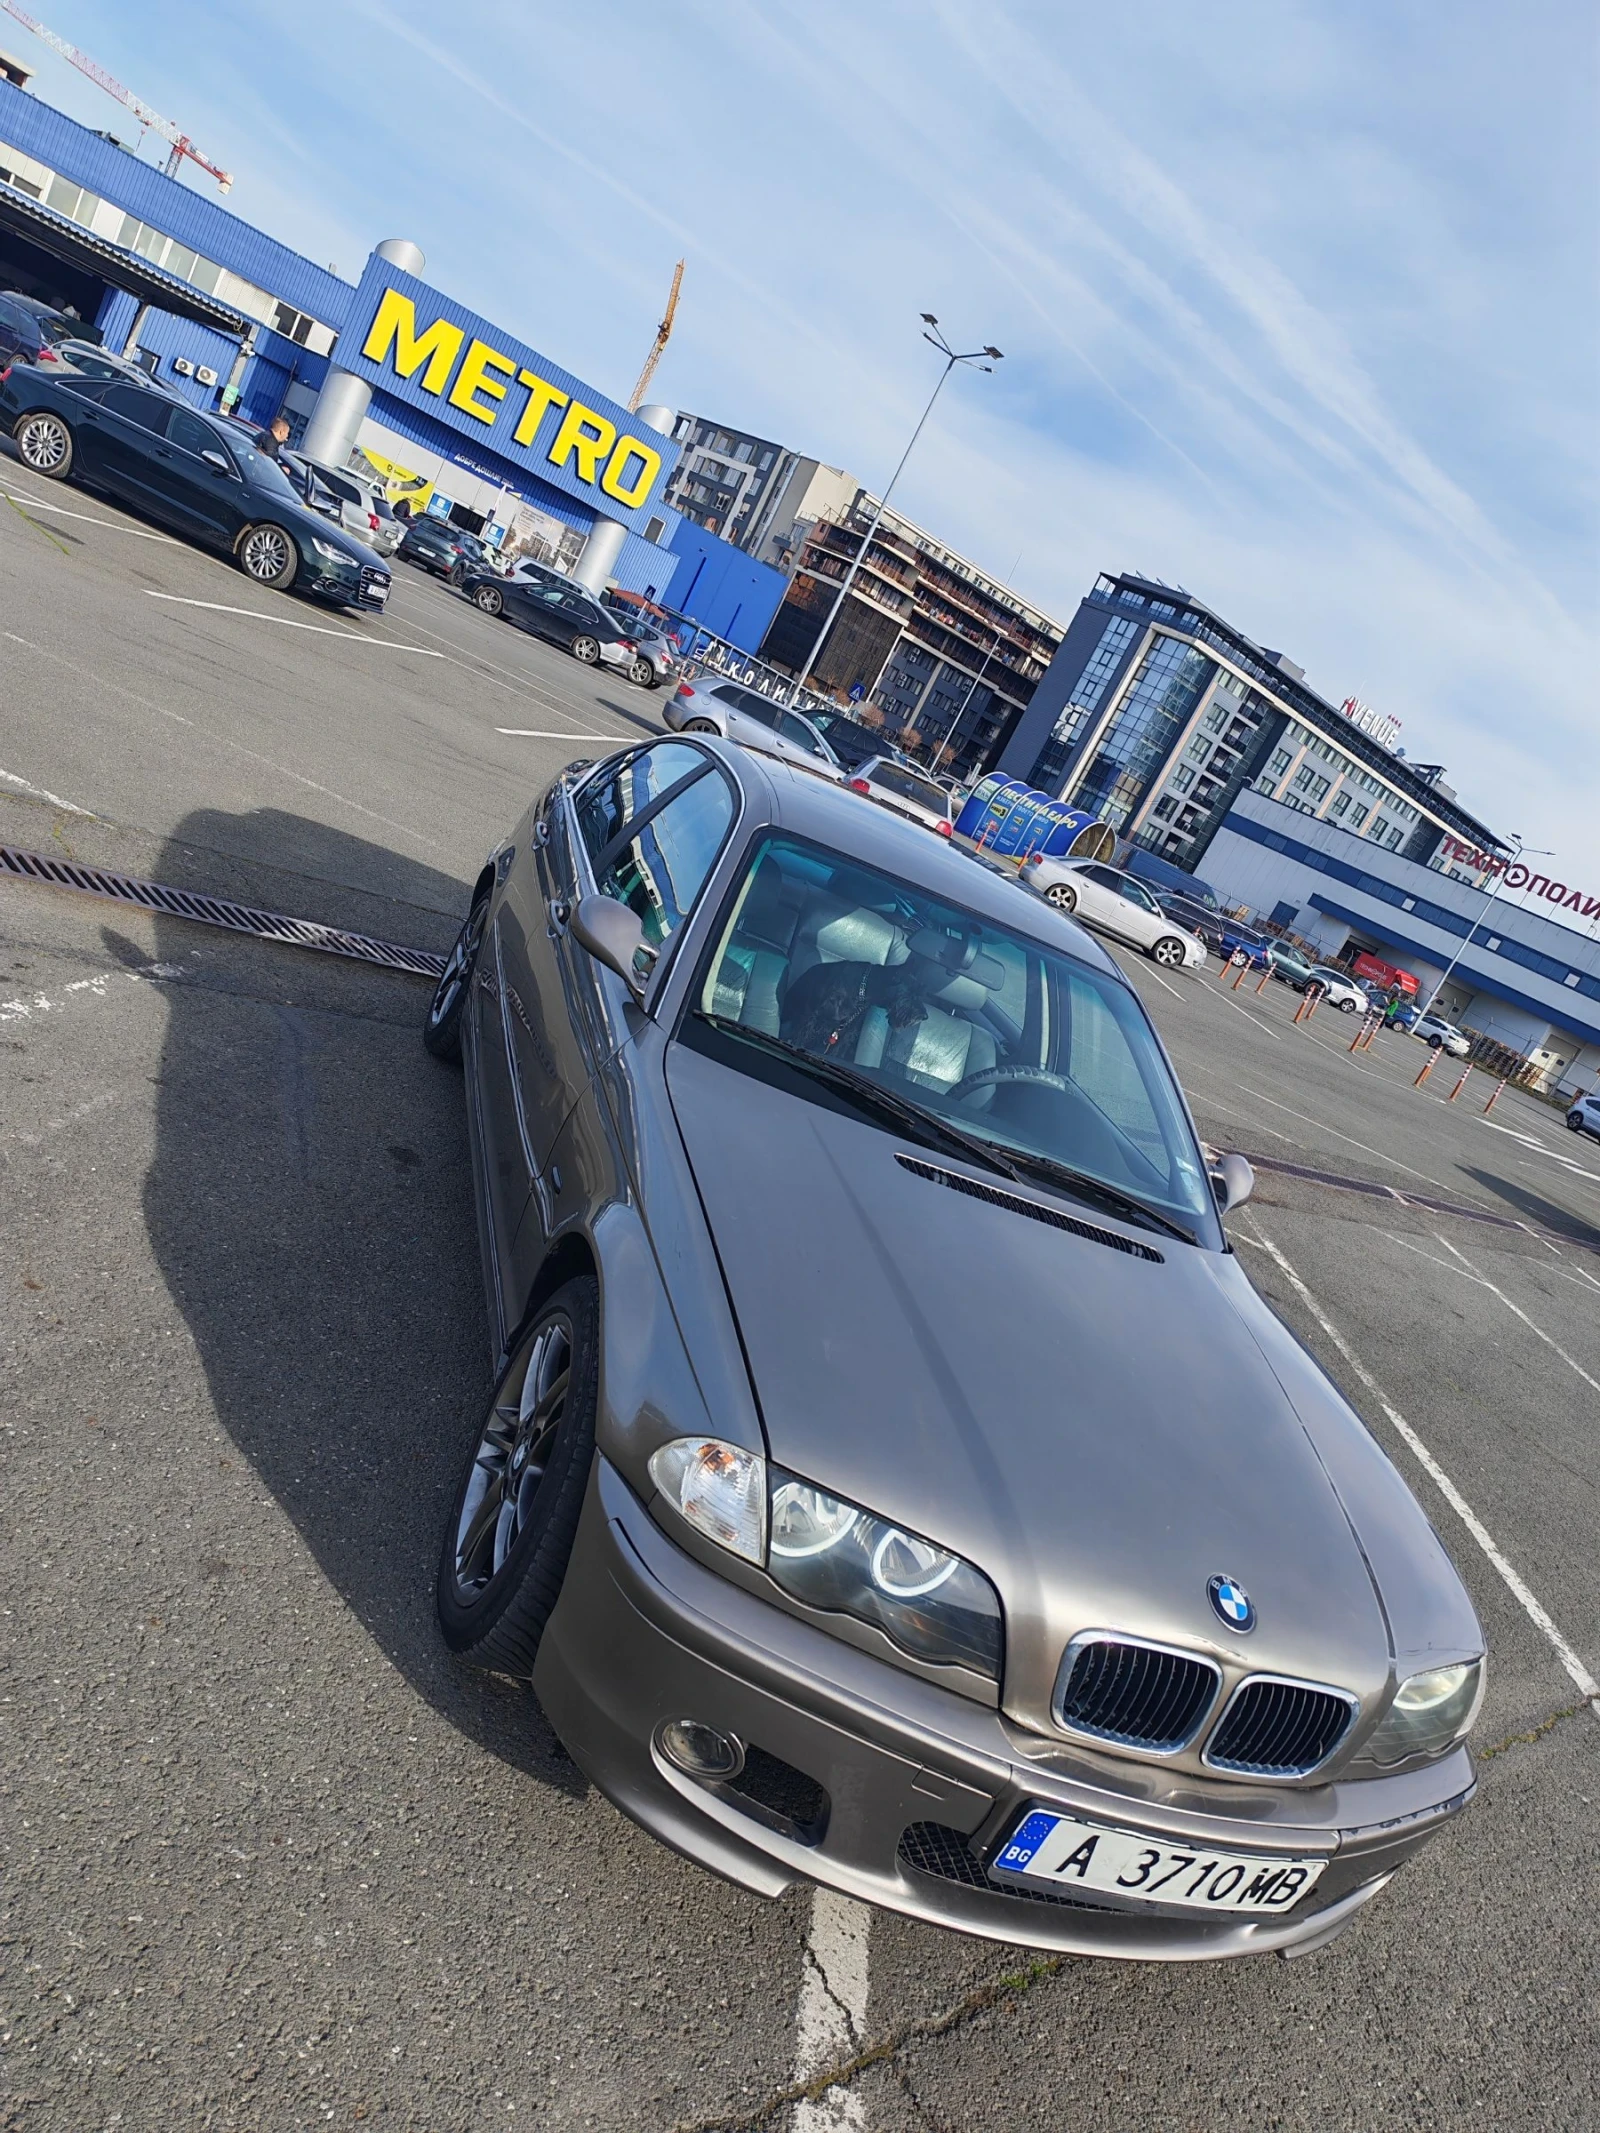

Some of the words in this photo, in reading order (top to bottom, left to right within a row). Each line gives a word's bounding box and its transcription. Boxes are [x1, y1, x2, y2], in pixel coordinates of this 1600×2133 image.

[362, 287, 662, 509] METRO
[454, 453, 477, 468] ДОБРЕ
[1340, 696, 1400, 748] AVENUE
[999, 808, 1007, 817] 3
[1000, 787, 1036, 809] ПЕСТИ
[1031, 800, 1050, 816] НА
[1045, 809, 1079, 830] ЕДРО
[1211, 1575, 1248, 1598] BMW
[1004, 1846, 1033, 1864] BG
[1055, 1835, 1101, 1877] A
[1116, 1848, 1246, 1901] 3710
[1236, 1866, 1309, 1905] MB
